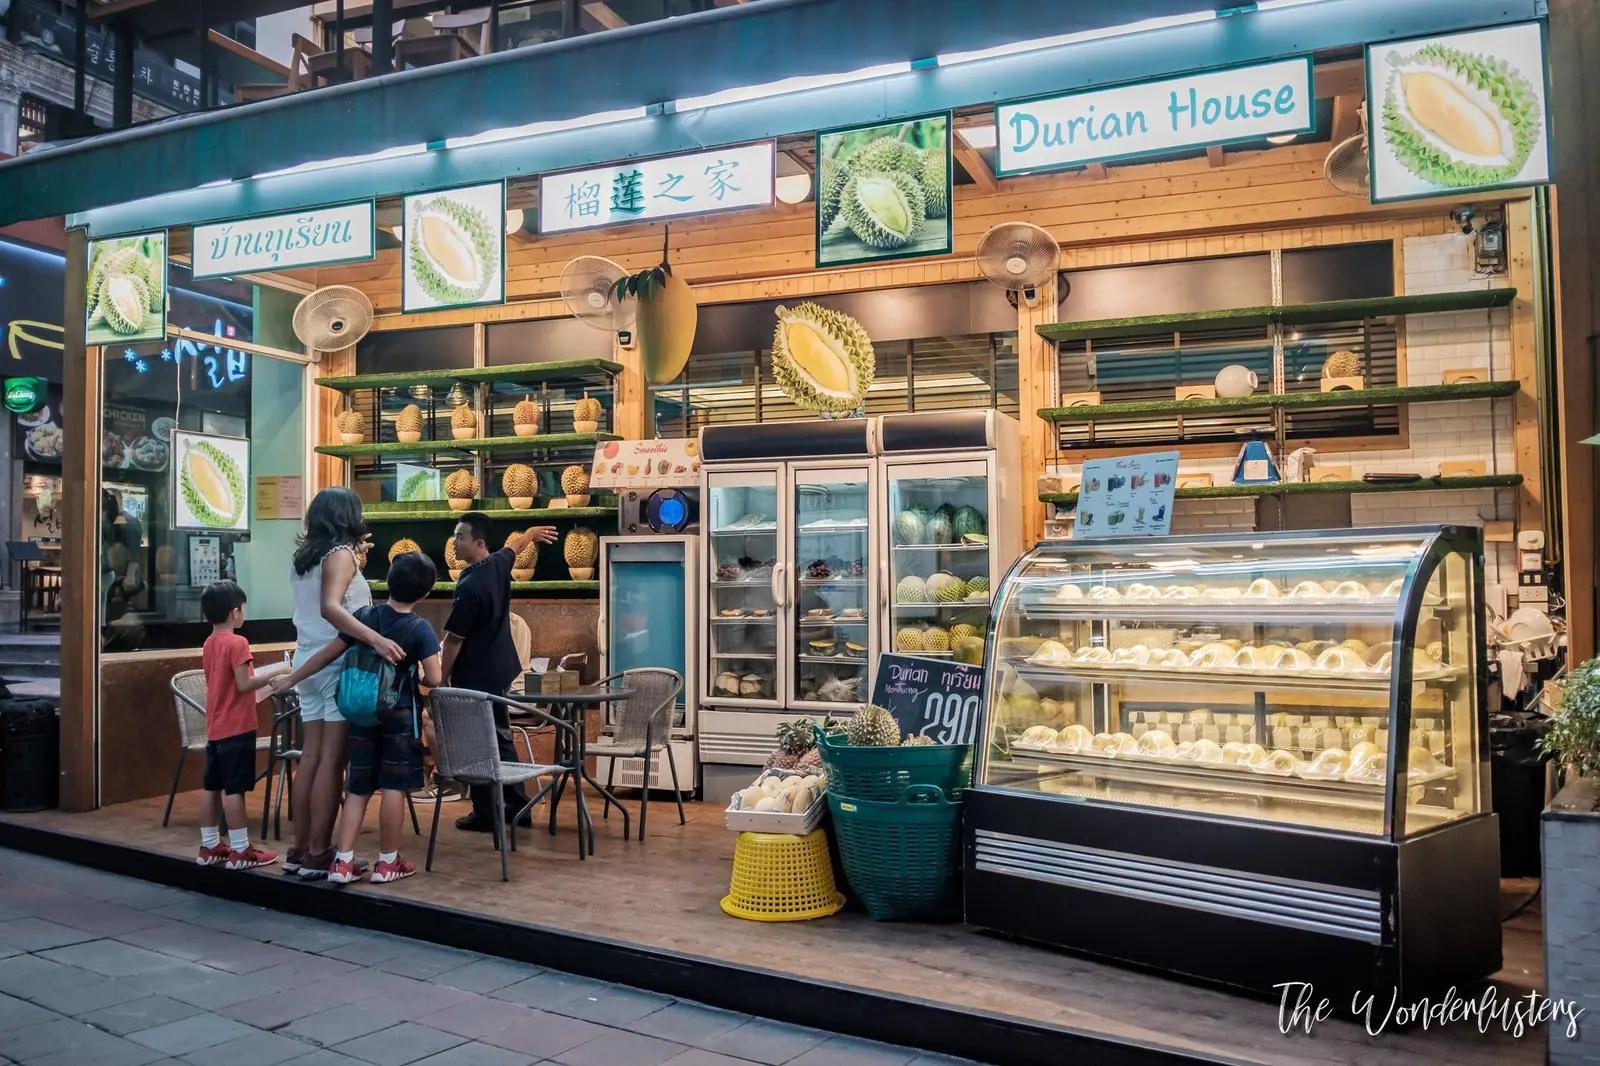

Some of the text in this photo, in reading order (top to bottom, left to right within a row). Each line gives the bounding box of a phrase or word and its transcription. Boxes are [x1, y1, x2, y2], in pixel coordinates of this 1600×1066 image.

[1009, 84, 1295, 153] Durian House
[563, 159, 742, 219] 榴莲之家
[210, 216, 352, 262] บ้านทุเรียน
[104, 408, 146, 423] CHICKEN
[887, 662, 928, 683] Durian
[942, 665, 982, 691] ทุเรียน
[919, 692, 980, 745] 290
